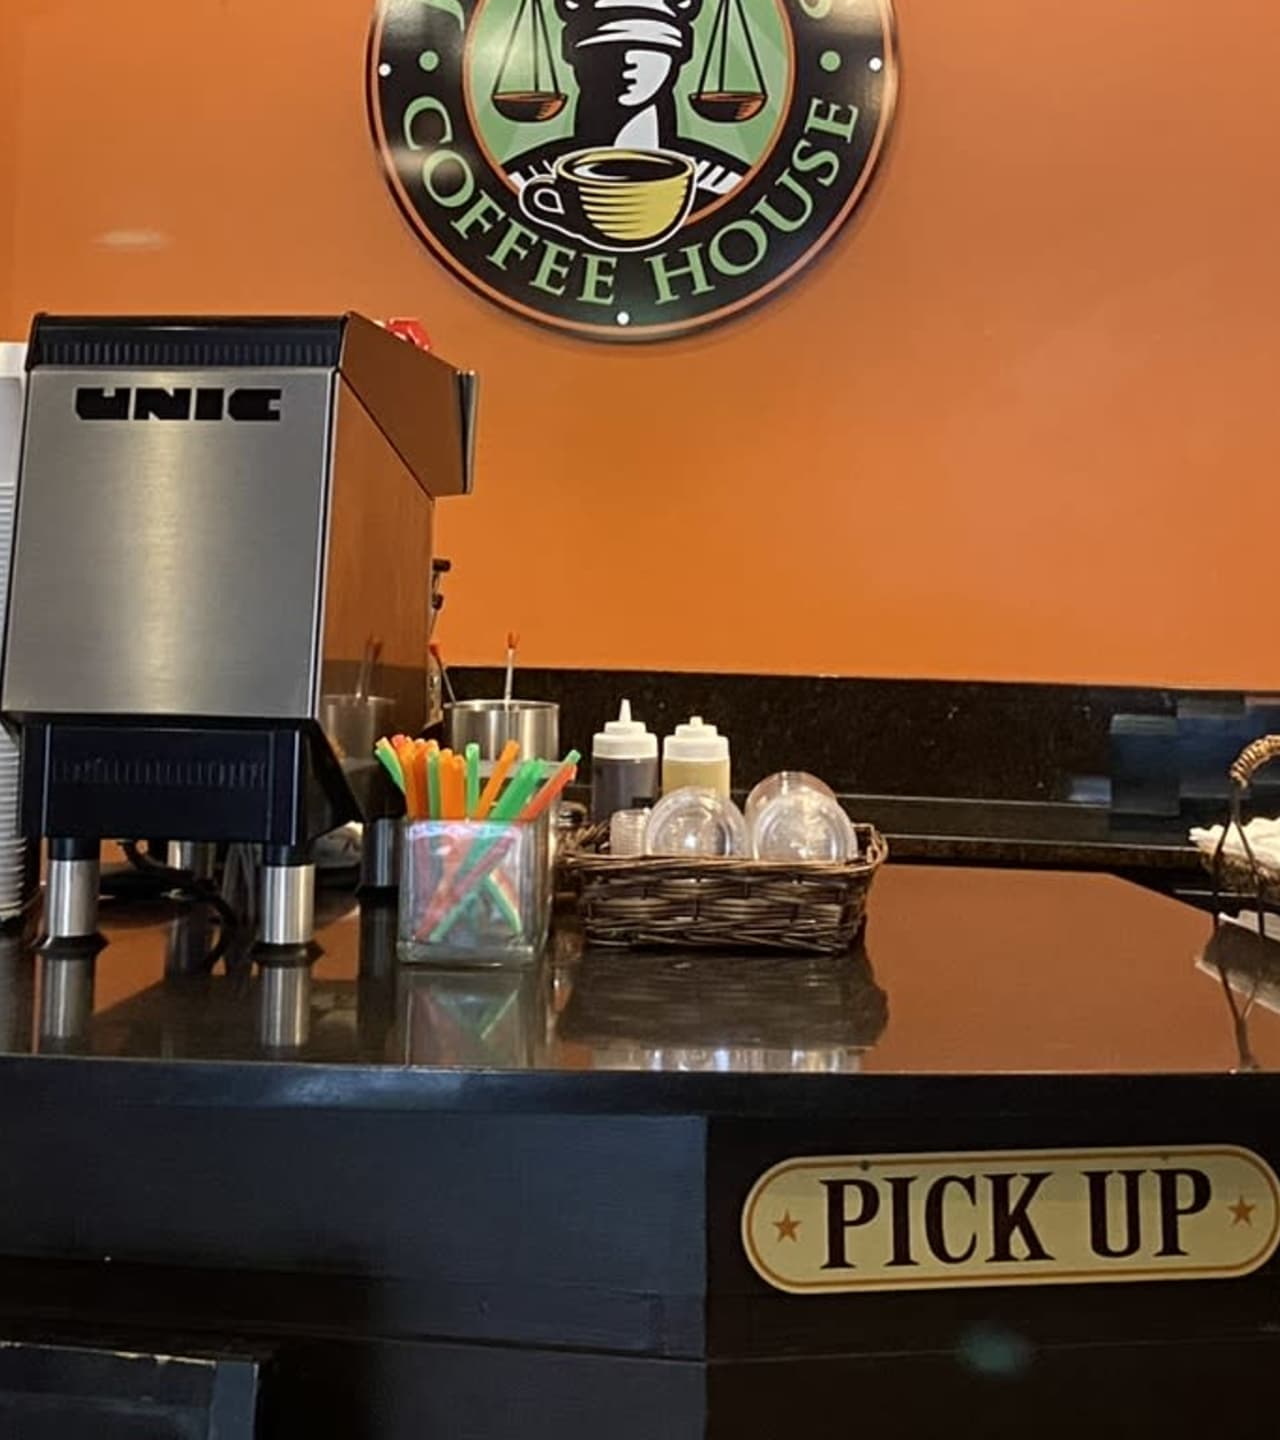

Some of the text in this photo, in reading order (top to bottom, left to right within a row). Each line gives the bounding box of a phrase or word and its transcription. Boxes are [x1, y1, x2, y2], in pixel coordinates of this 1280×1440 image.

[403, 96, 858, 304] COFFEE HOUSE
[76, 388, 281, 421] UNIC
[820, 1168, 1212, 1269] PICK UP
